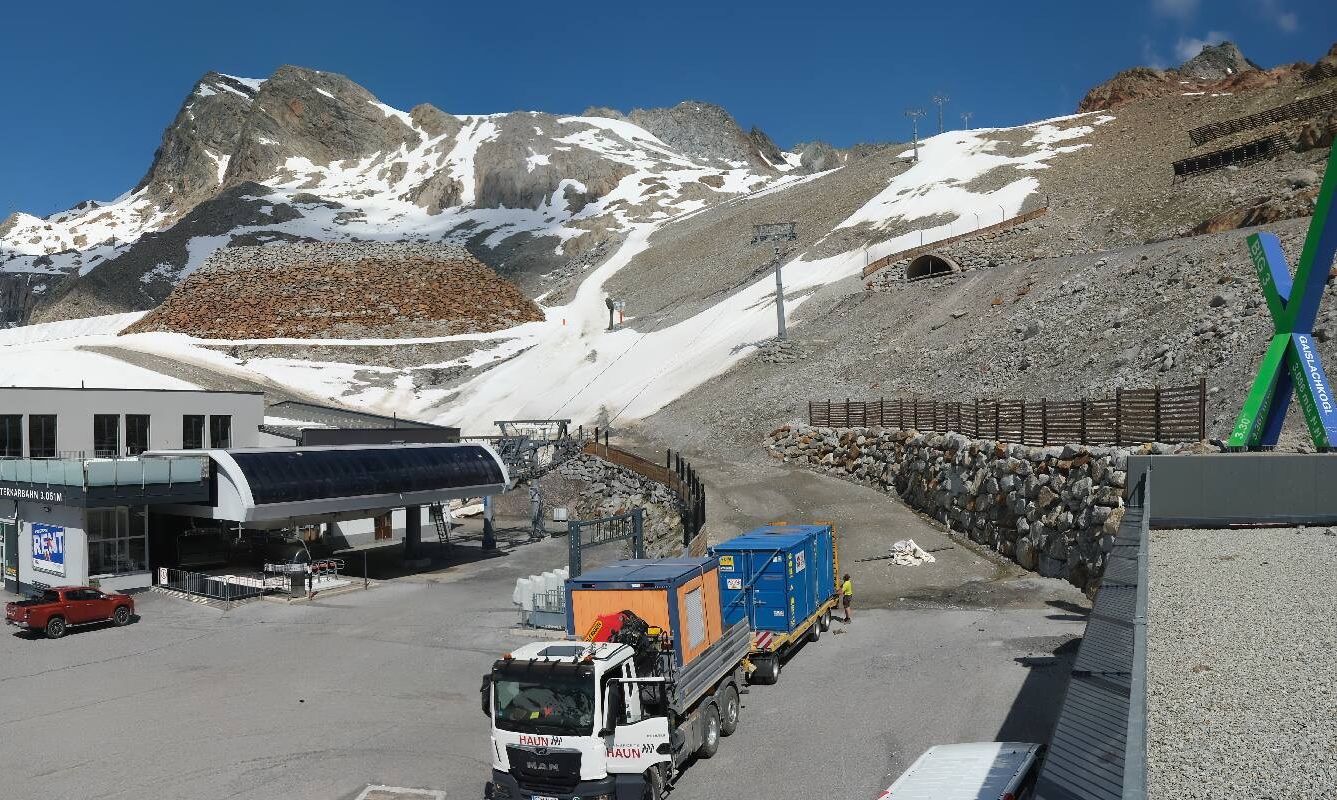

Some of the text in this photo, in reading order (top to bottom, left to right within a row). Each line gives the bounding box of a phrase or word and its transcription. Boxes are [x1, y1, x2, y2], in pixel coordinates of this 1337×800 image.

[1251, 239, 1271, 286] BIG 3
[1299, 335, 1333, 416] GAISLACHKOGL
[33, 531, 64, 556] RENT
[519, 735, 549, 746] HAUN
[606, 747, 641, 759] HAUN
[527, 761, 560, 772] MAN
